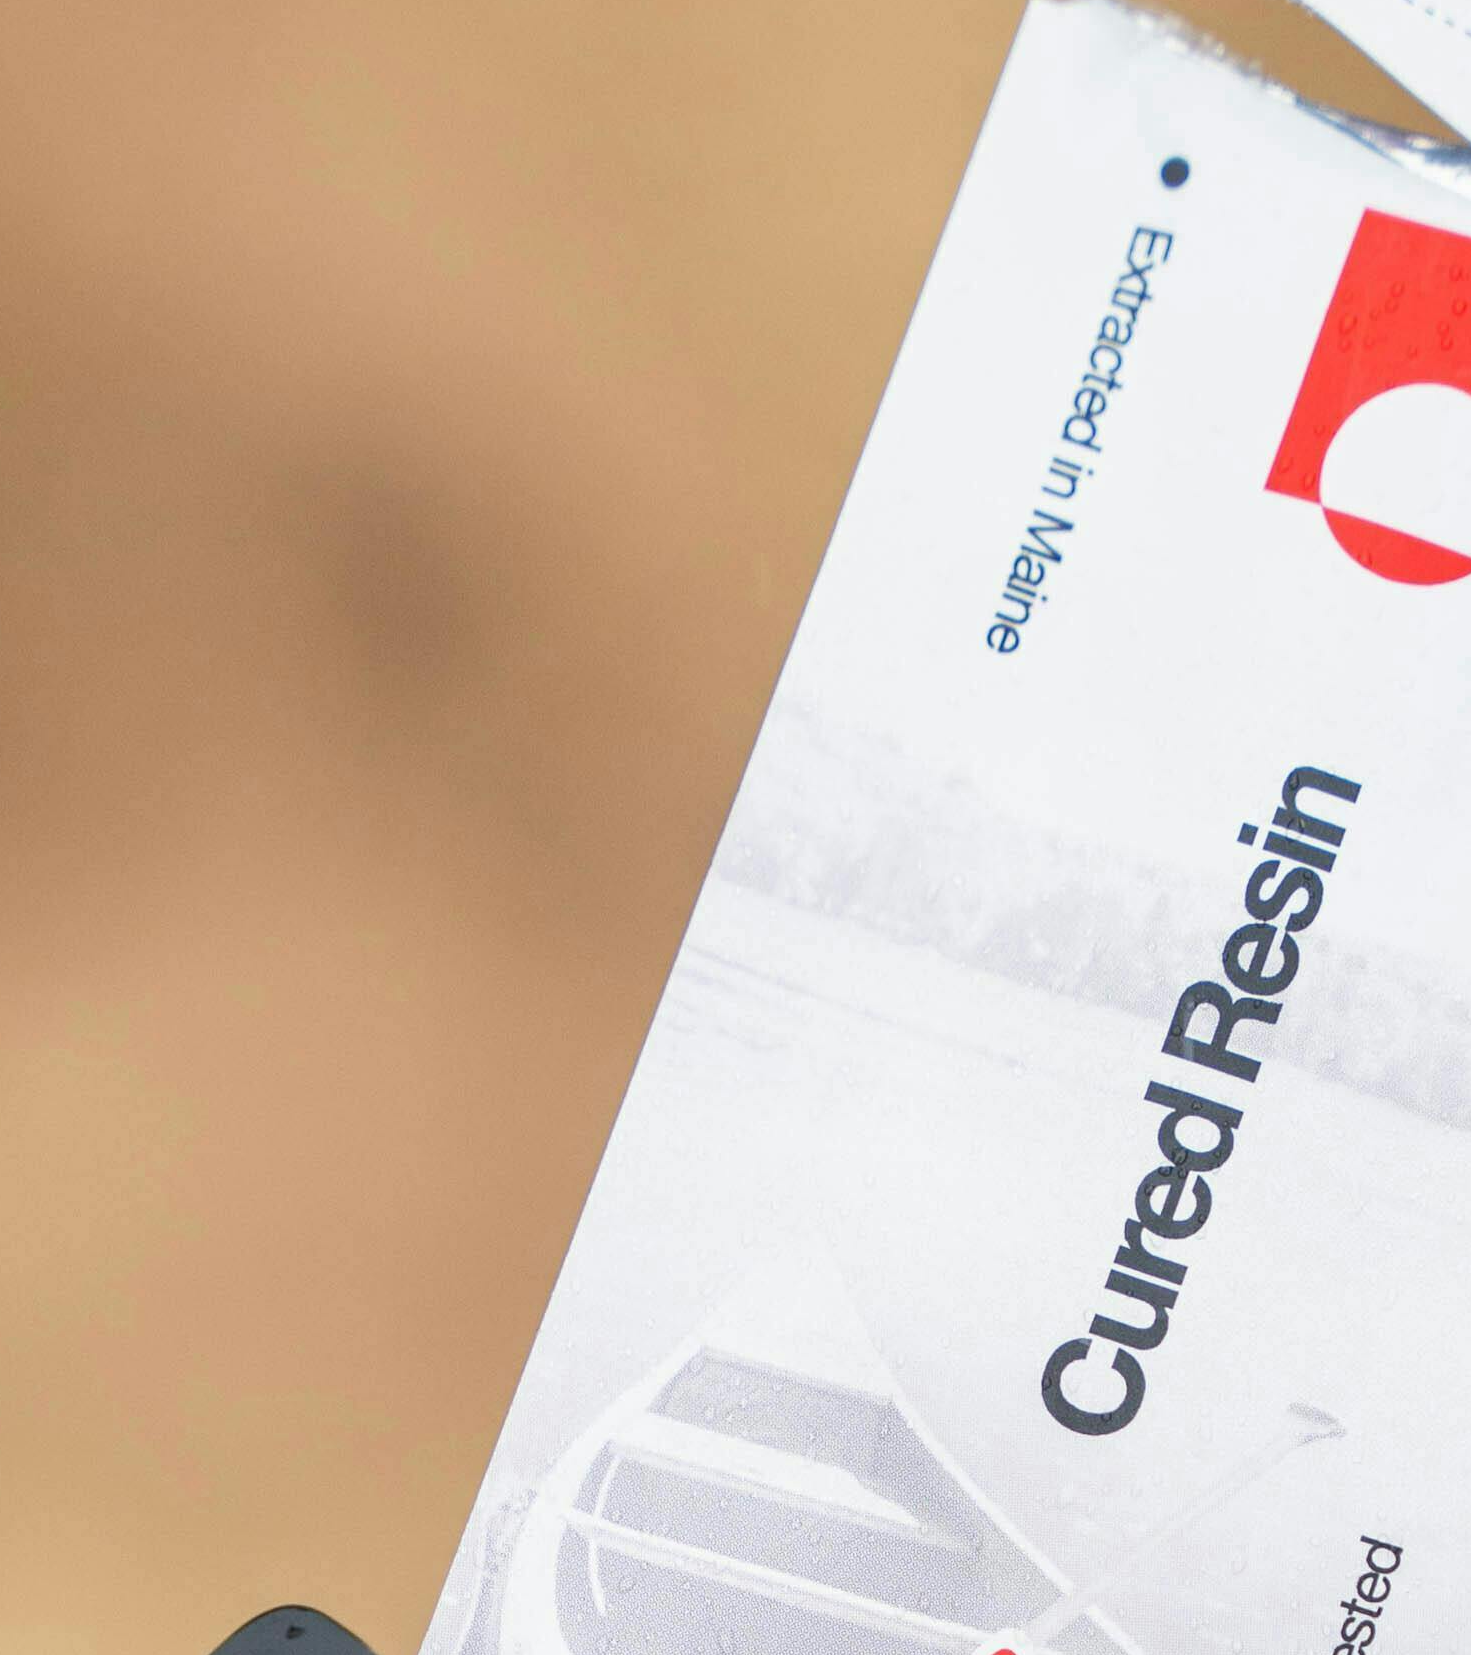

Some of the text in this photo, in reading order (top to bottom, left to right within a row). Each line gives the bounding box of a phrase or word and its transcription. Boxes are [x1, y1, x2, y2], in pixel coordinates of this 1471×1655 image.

[986, 225, 1174, 655] Extracted in Maine
[1040, 765, 1362, 1437] Cured Resin
